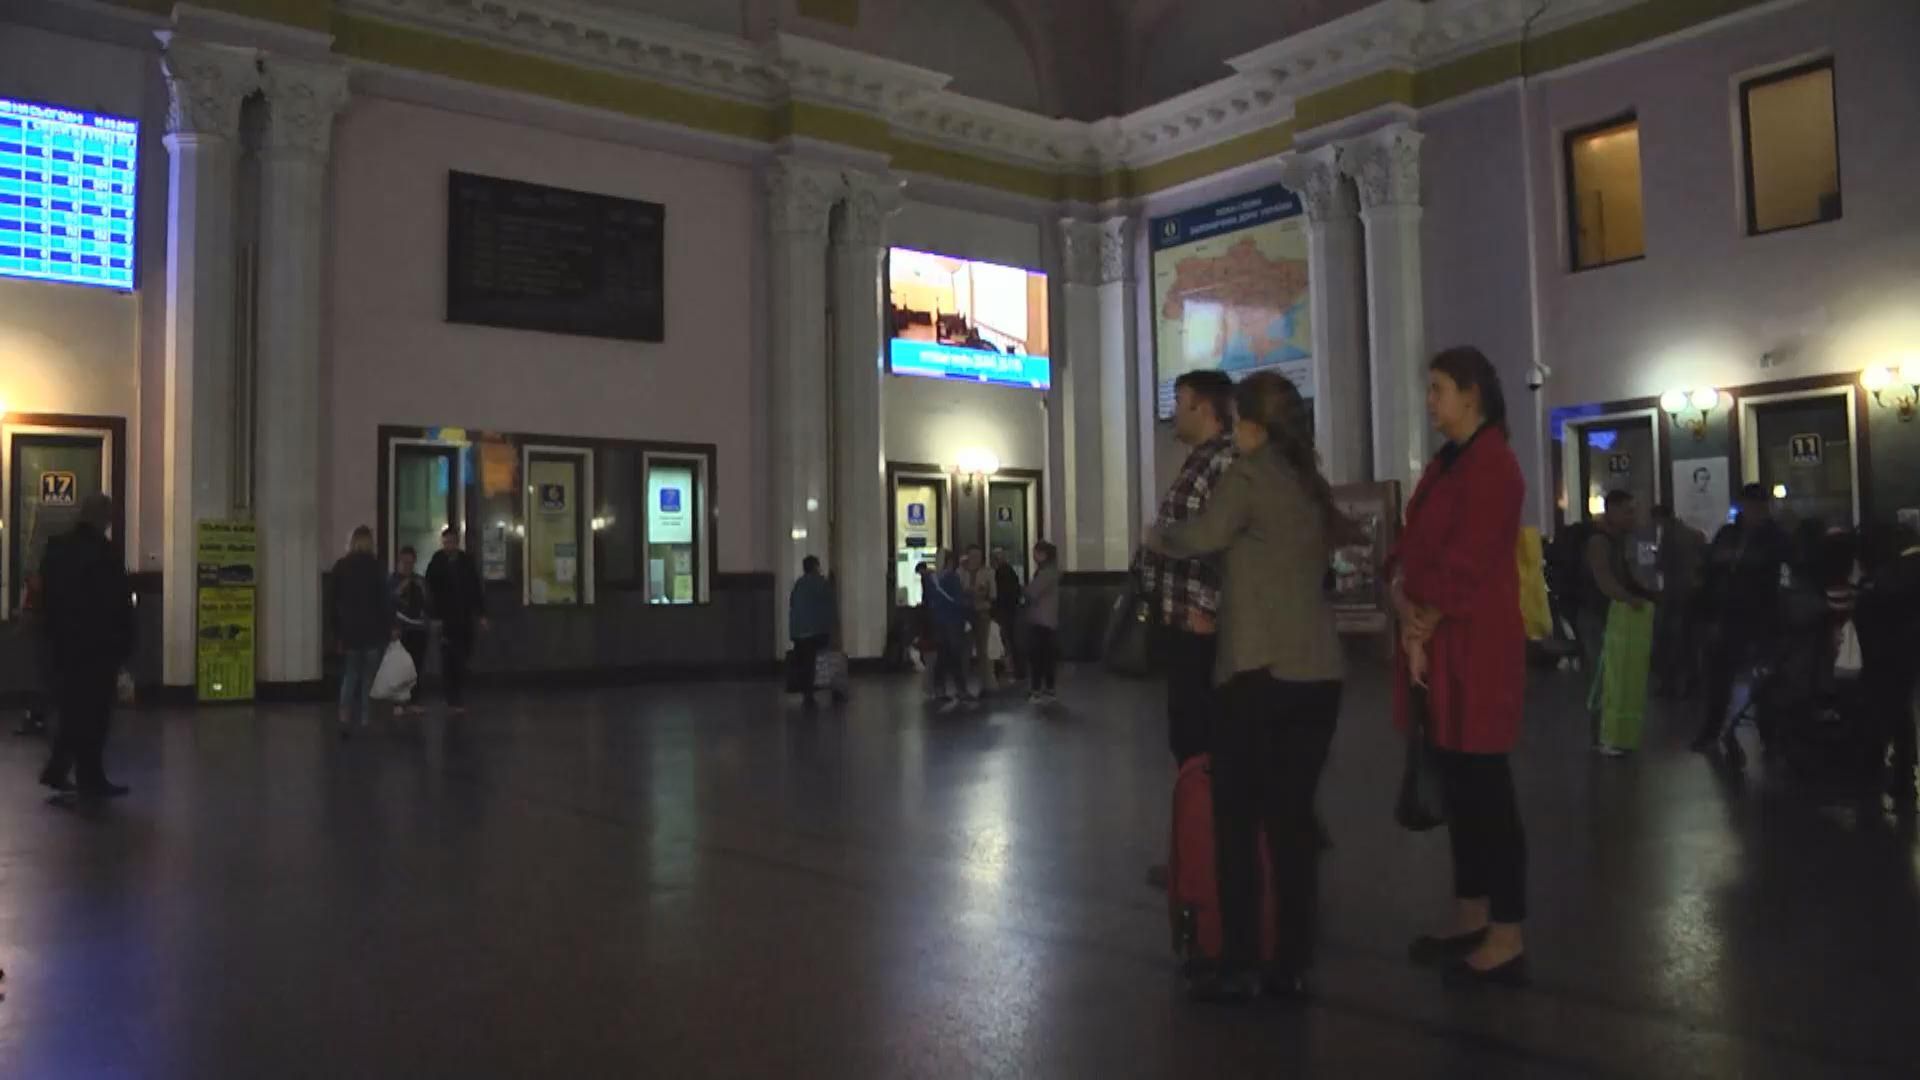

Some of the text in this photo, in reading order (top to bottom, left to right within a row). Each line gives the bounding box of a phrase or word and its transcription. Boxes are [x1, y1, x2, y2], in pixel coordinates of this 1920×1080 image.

[1794, 439, 1816, 454] 11
[1612, 456, 1630, 470] 10
[46, 477, 71, 493] 17
